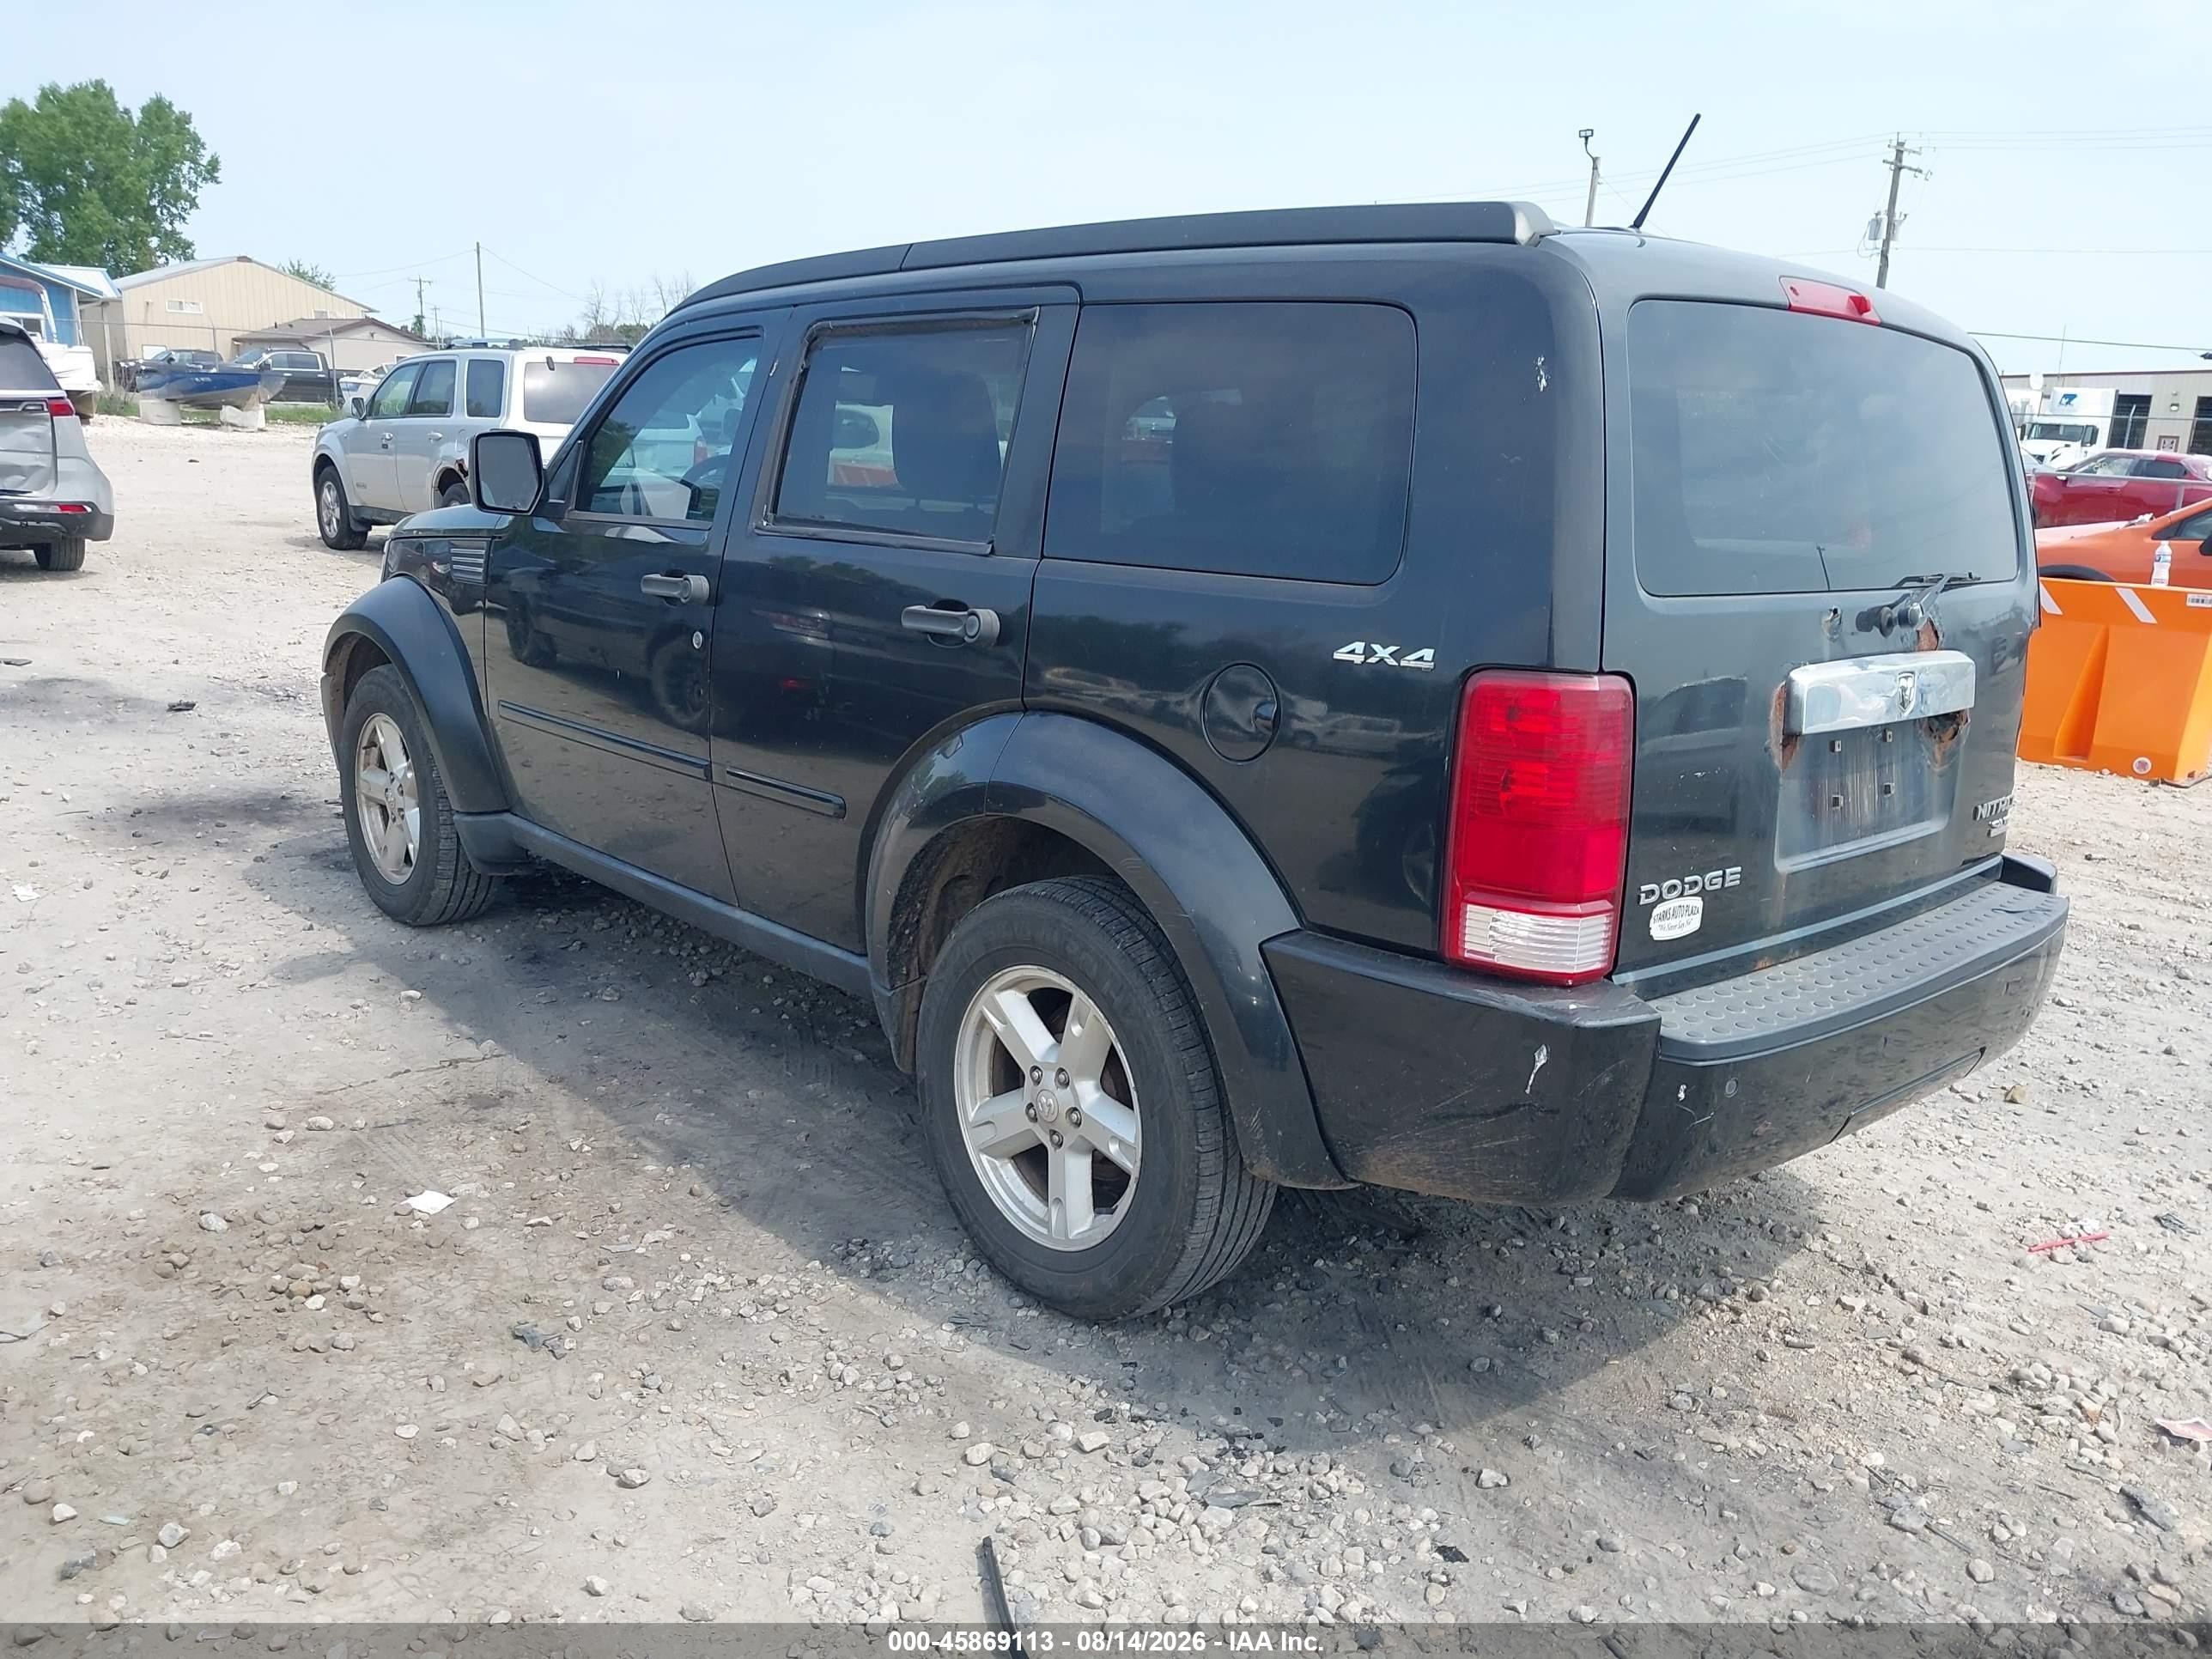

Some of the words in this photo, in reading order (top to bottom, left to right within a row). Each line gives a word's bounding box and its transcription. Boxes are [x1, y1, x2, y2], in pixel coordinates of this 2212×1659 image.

[1333, 641, 1435, 672] 4X4
[1638, 866, 1742, 905] DODGE
[1671, 904, 1685, 920] AUTO
[1685, 904, 1699, 917] PLAZA
